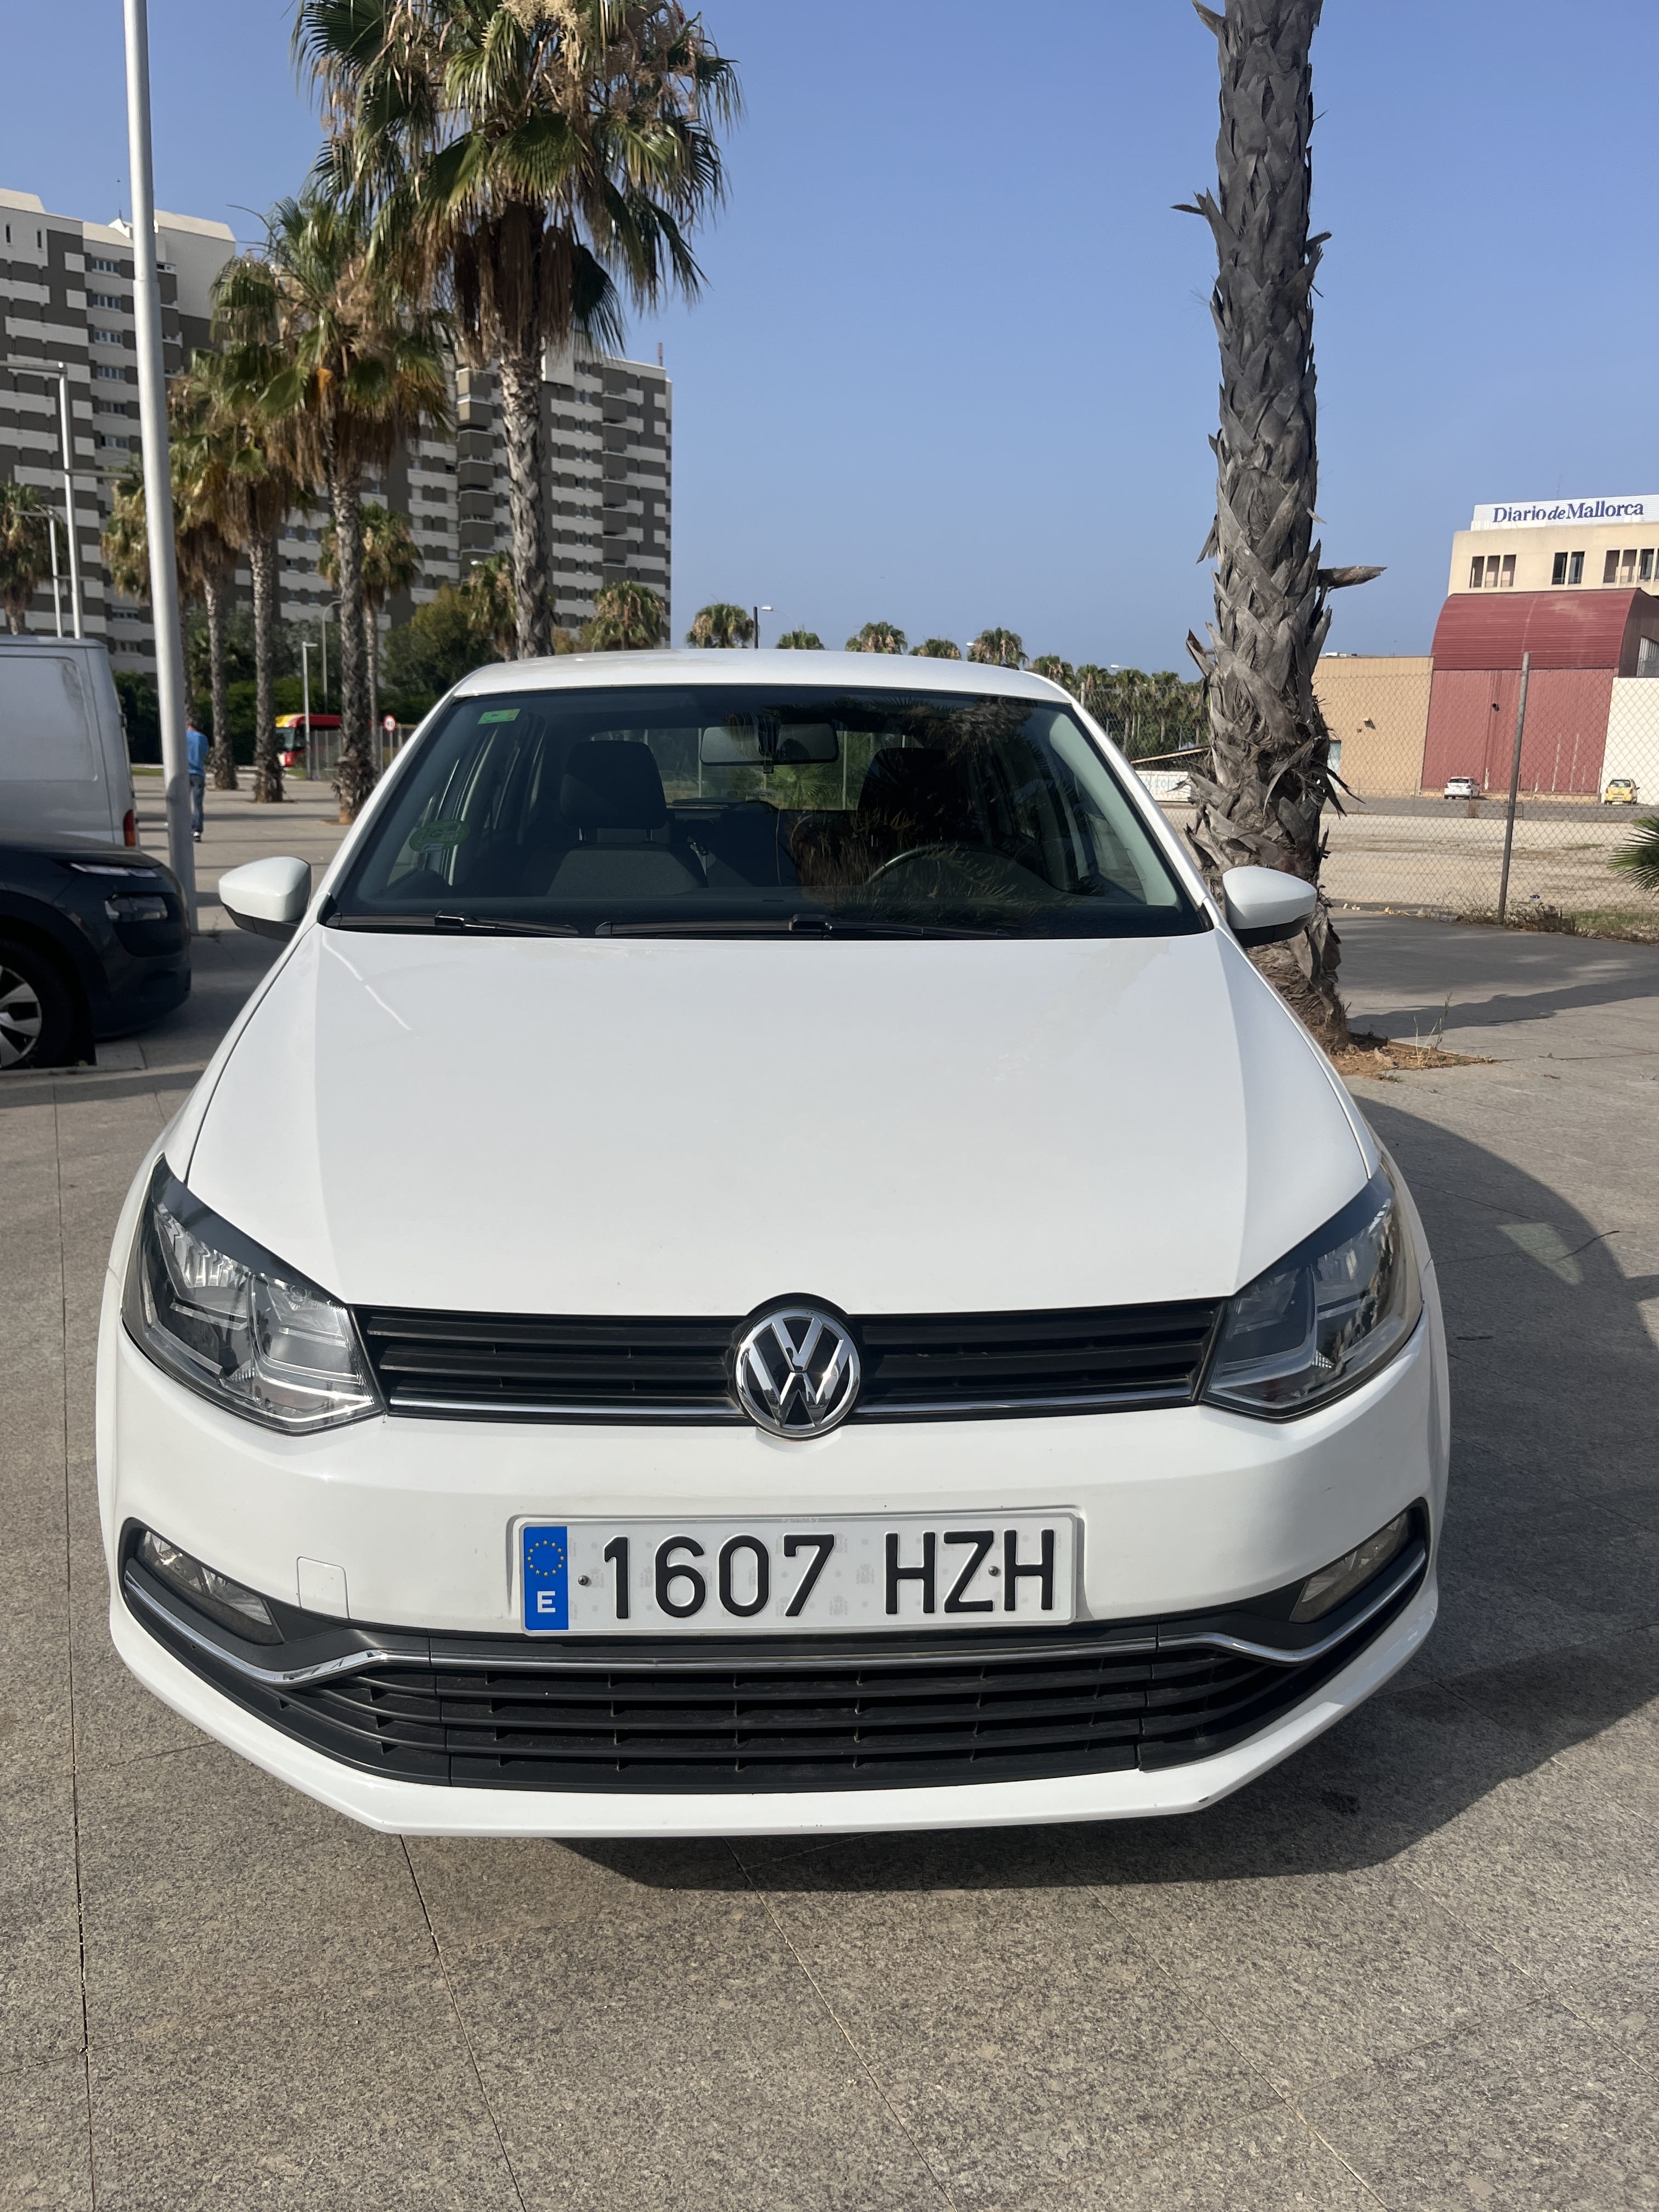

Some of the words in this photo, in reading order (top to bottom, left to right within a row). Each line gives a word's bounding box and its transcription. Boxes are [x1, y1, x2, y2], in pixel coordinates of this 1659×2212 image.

[1492, 506, 1546, 522] Diario
[1548, 506, 1566, 520] de
[1567, 500, 1644, 519] Mallorca
[736, 1308, 860, 1438] VW
[537, 1590, 556, 1613] E
[604, 1534, 834, 1619] 1607
[885, 1529, 1054, 1614] HZH
